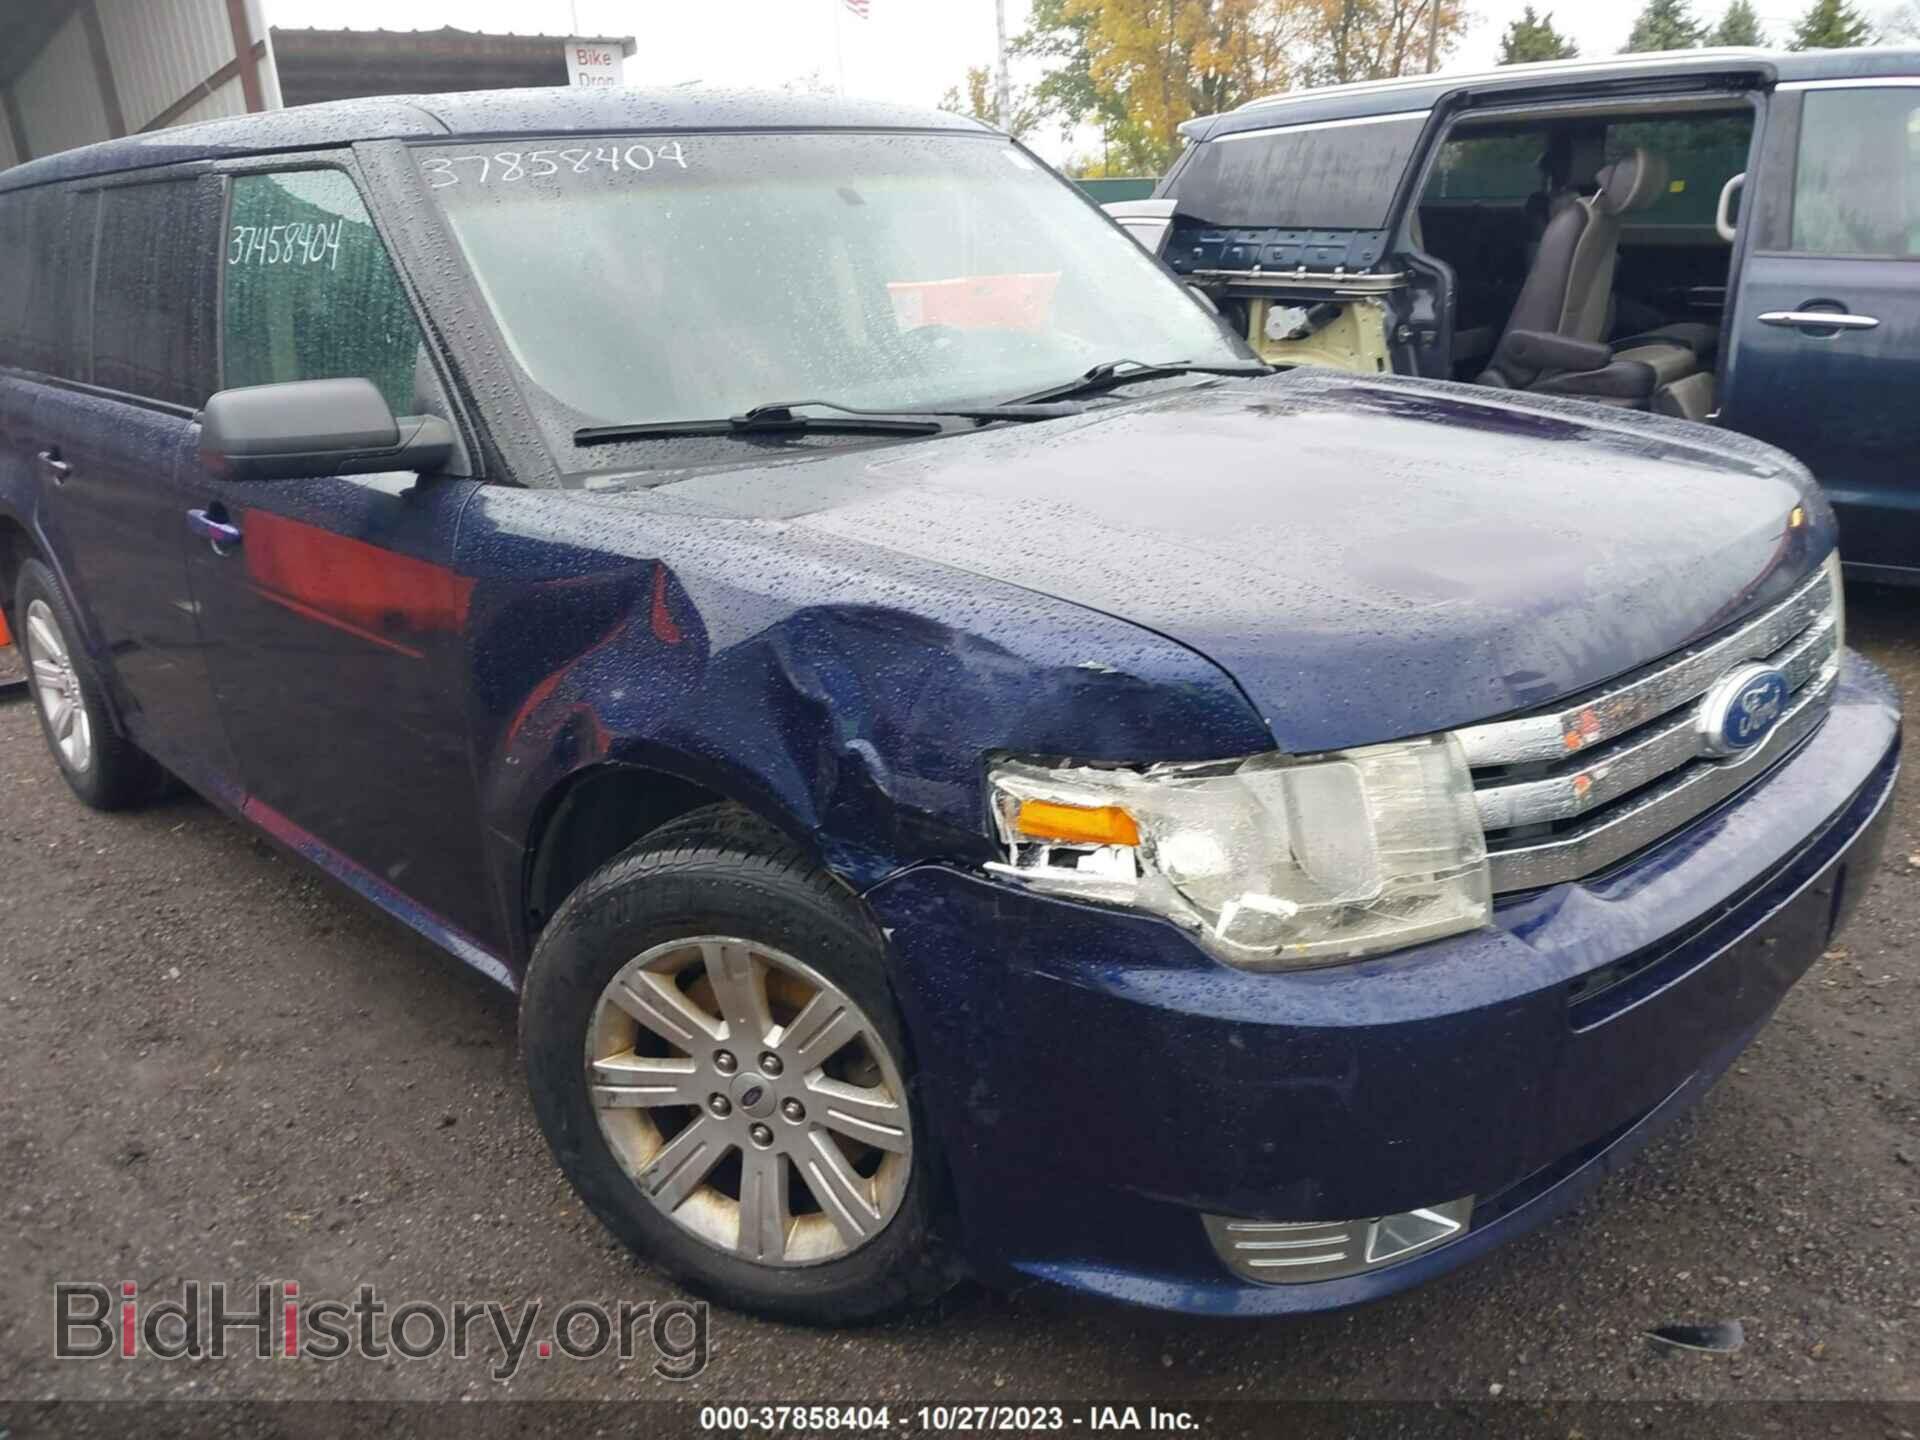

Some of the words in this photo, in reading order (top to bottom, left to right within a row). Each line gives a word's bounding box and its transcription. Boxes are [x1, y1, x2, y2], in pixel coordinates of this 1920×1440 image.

[576, 48, 611, 65] Bike
[421, 141, 689, 188] 37858404
[228, 219, 343, 271] 37458404
